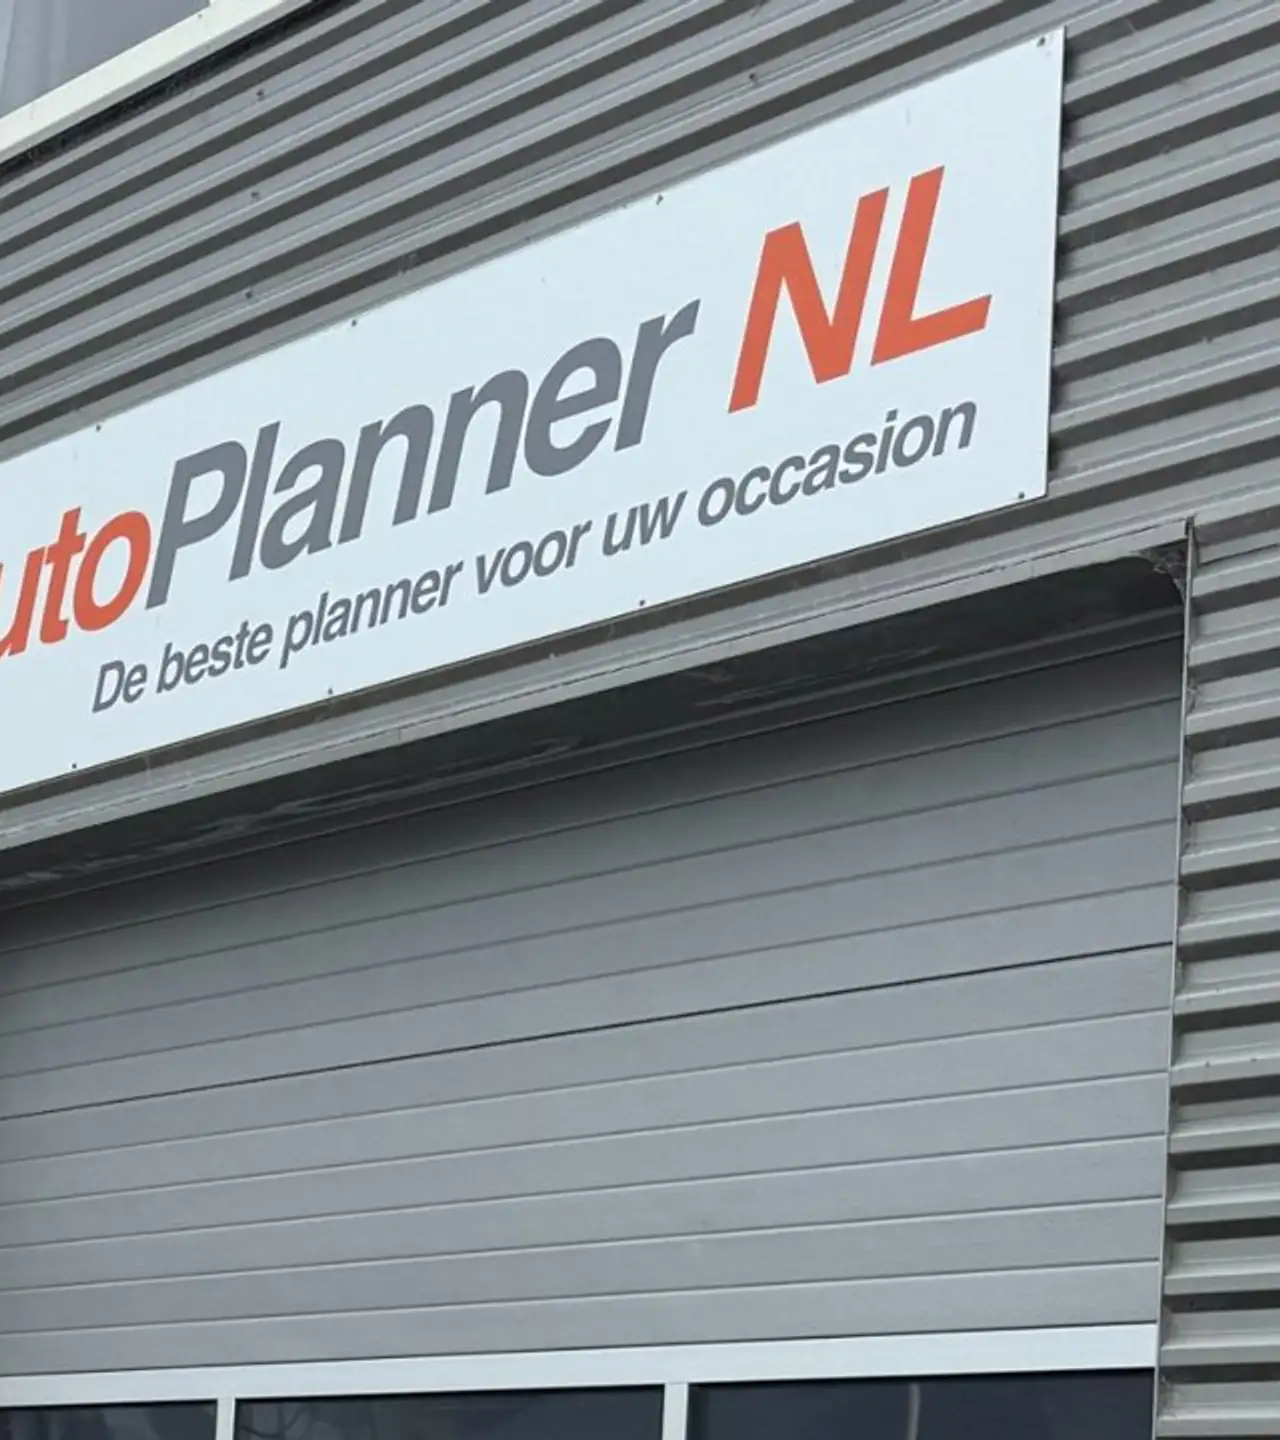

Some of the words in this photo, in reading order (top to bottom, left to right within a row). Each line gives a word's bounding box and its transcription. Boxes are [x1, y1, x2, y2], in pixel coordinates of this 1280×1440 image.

[728, 166, 992, 413] NL
[92, 661, 148, 713] De
[156, 621, 274, 693] beste
[280, 571, 464, 669] planner
[477, 521, 593, 594] voor
[603, 491, 688, 556] uw
[698, 402, 977, 526] occasion
